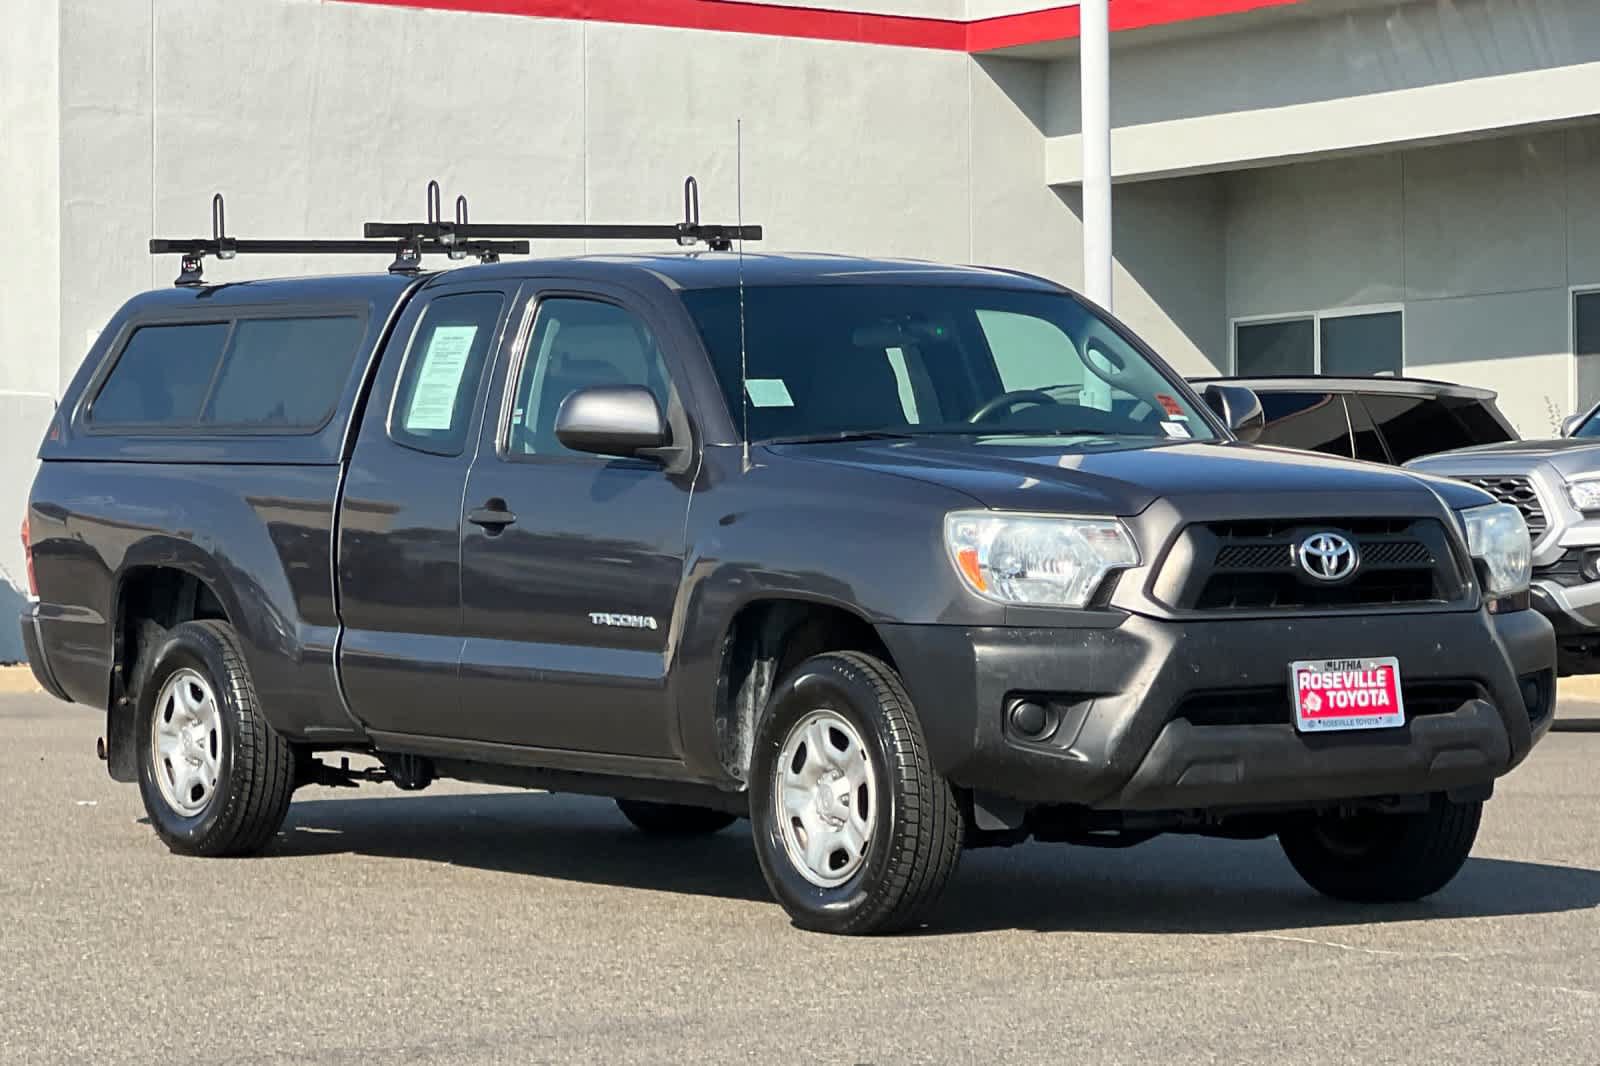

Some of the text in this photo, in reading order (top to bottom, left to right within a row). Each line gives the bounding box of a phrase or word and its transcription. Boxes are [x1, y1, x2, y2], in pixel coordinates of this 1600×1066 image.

[588, 612, 658, 630] TACOMA
[1333, 660, 1362, 671] LITHIA
[1299, 670, 1387, 690] ROSEVILLE
[1326, 689, 1389, 709] TOYOTA
[1321, 718, 1379, 728] ROSEVILLE TOYOTA
